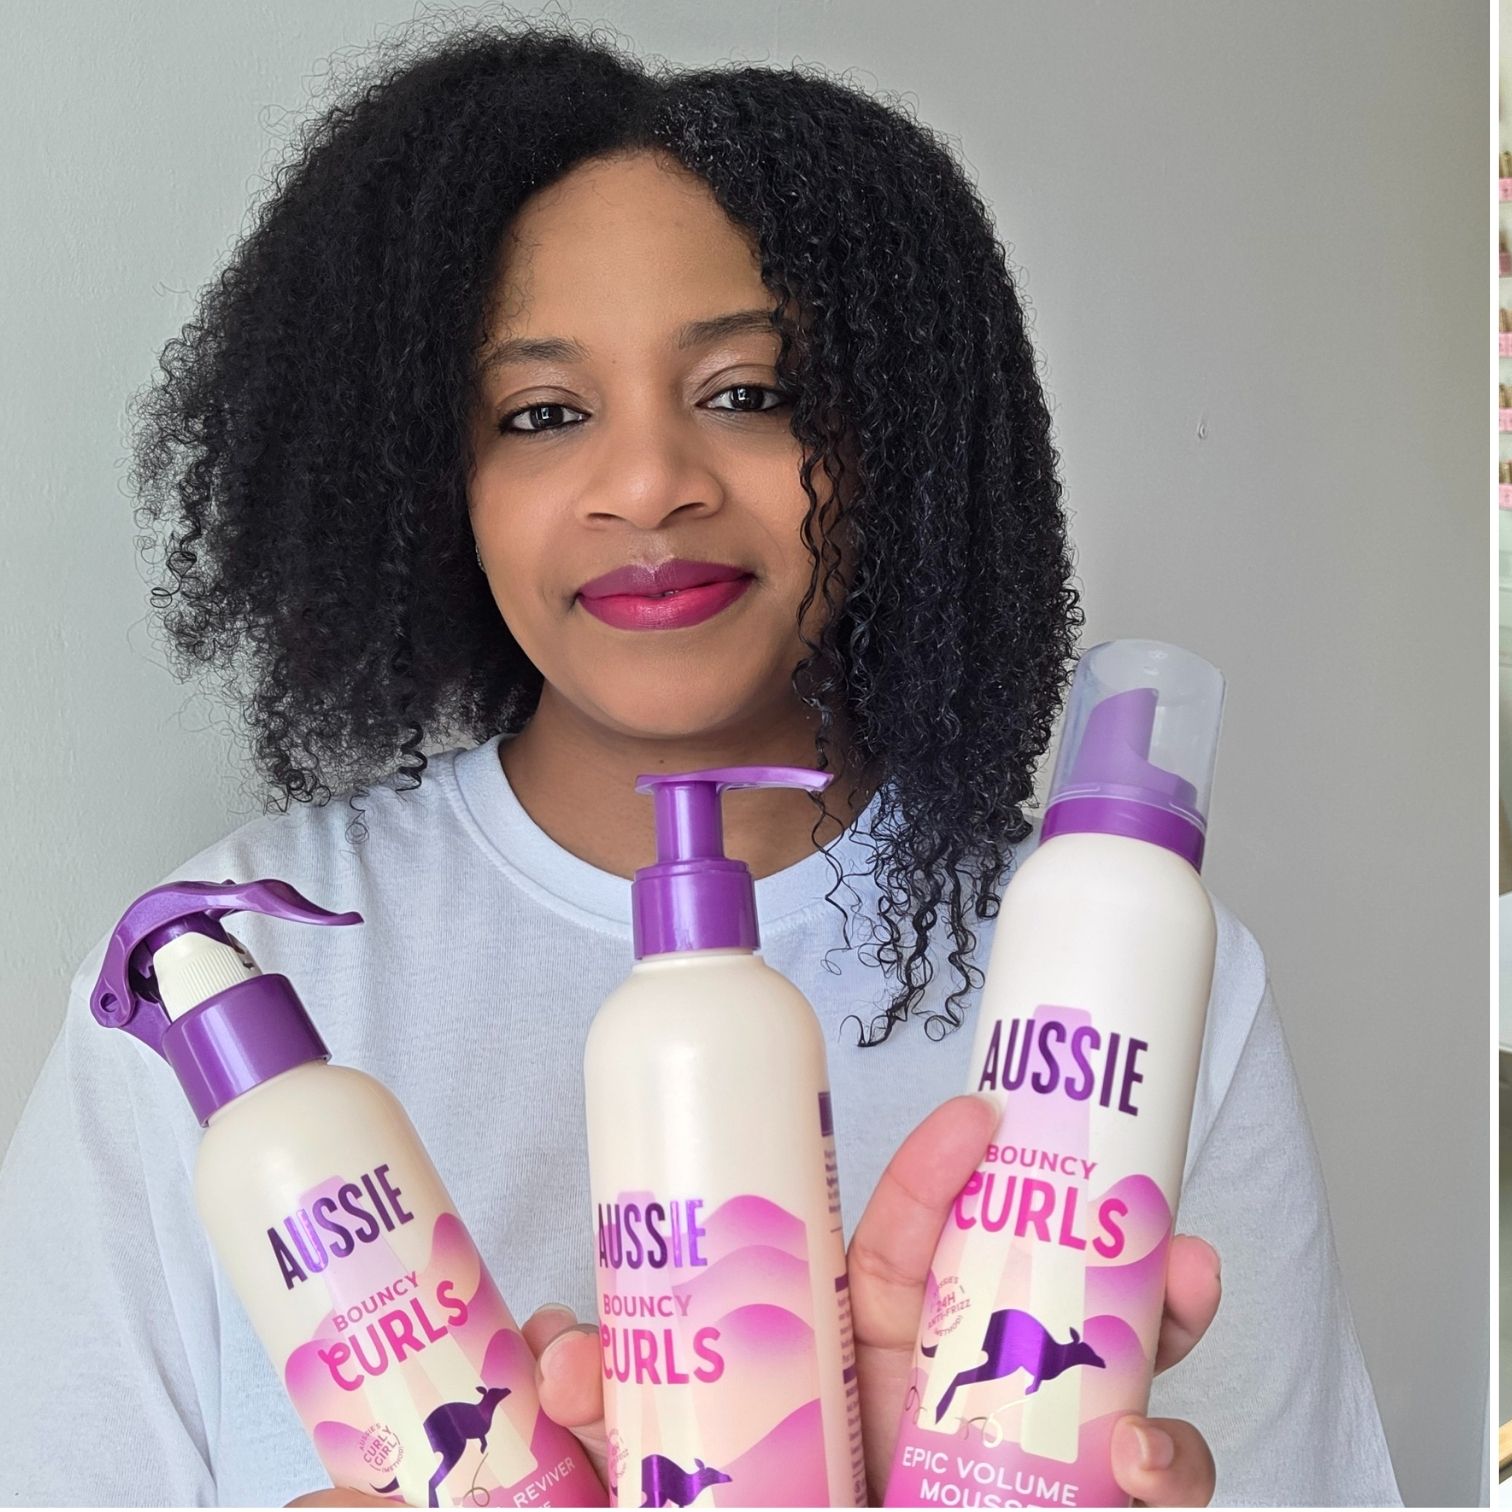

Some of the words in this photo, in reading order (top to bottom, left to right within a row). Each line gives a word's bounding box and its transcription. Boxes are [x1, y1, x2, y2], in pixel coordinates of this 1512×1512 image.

[978, 1019, 1148, 1116] AUSSIE
[985, 1145, 1096, 1179] BOUNCY
[267, 1164, 414, 1290] AUSSIE
[598, 1199, 707, 1269] AUSSIE
[954, 1170, 1128, 1259] CURLS
[332, 1271, 420, 1333] BOUNCY
[603, 1294, 693, 1317] BOUNCY
[318, 1280, 469, 1391] CURLS
[599, 1320, 725, 1385] CURLS
[363, 1425, 392, 1463] CURLY
[374, 1441, 397, 1466] GIRL
[513, 1456, 576, 1508] REVIVER
[903, 1446, 948, 1473] EPIC
[957, 1457, 1079, 1506] VOLUME
[920, 1478, 1043, 1508] MOUS
